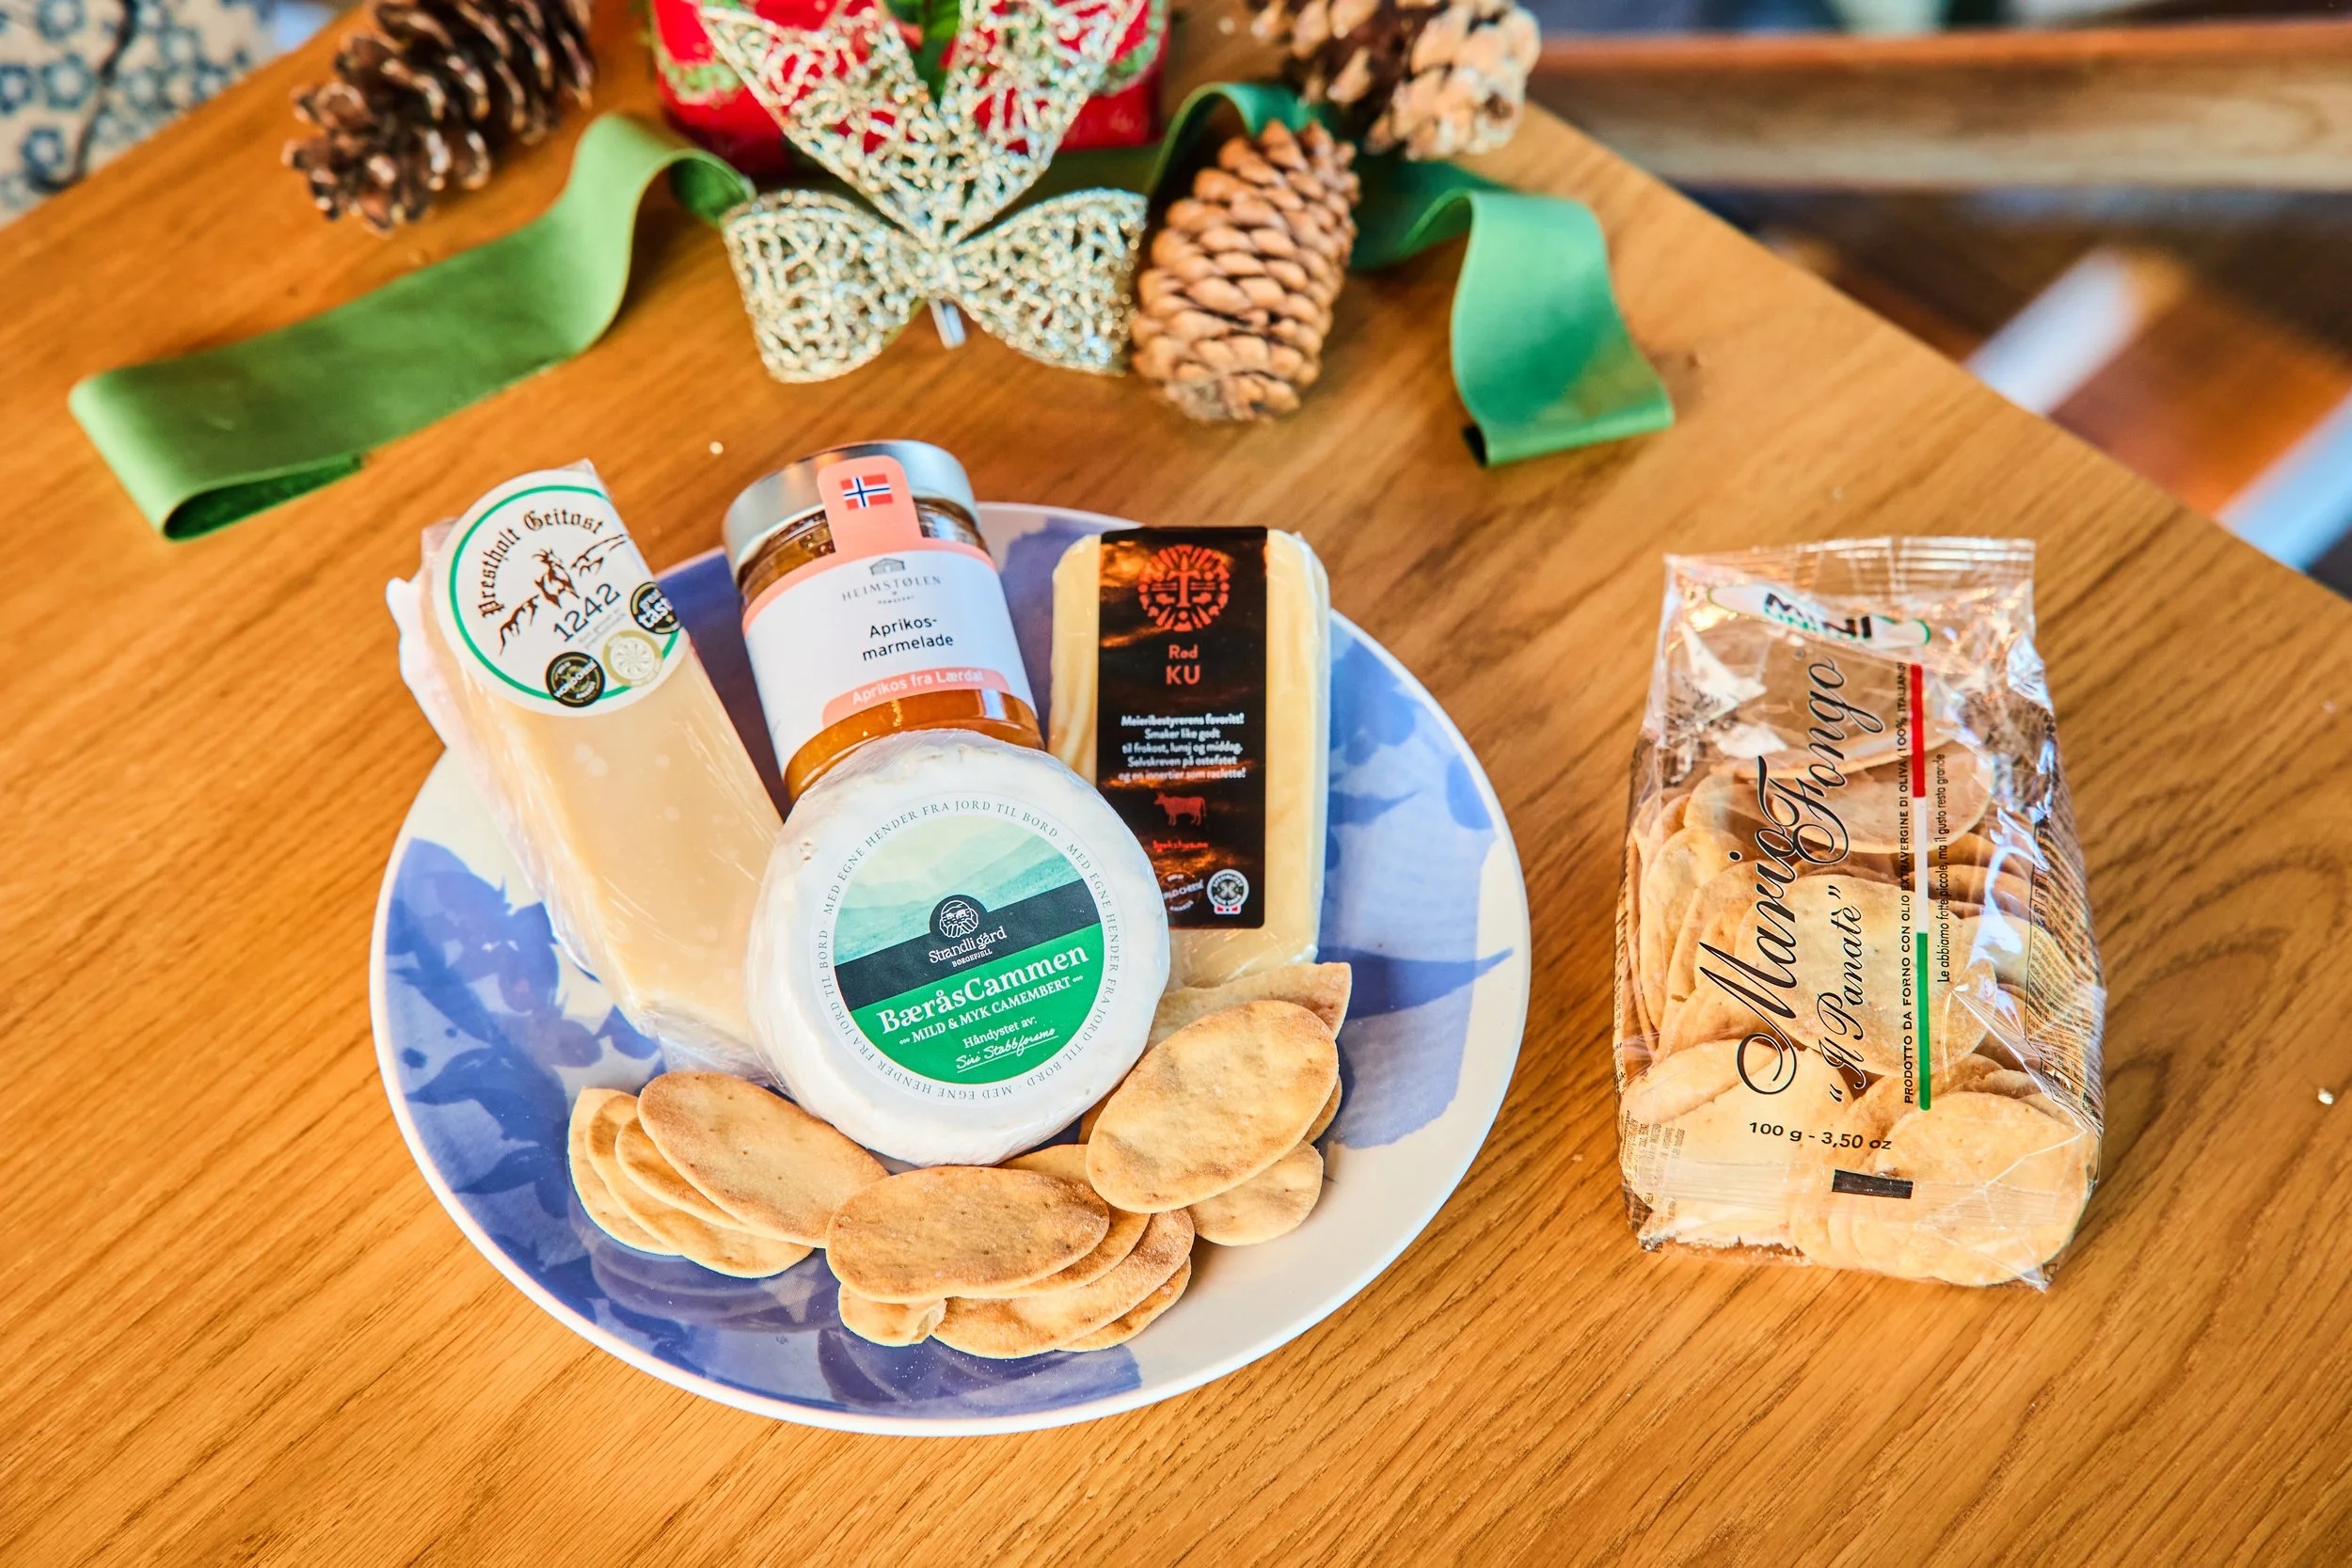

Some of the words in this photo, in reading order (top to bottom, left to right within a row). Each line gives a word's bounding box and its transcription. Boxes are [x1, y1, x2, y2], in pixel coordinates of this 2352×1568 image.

[841, 576, 942, 602] HEIMSTØLEN
[553, 583, 621, 641] 1242
[869, 617, 937, 639] Aprikos-
[863, 634, 954, 661] marmelade
[852, 679, 908, 705] Aprikos
[910, 673, 932, 688] fra
[935, 670, 984, 684] Lærdal
[1166, 664, 1200, 685] KU
[1899, 760, 1908, 793] OLIVA
[1932, 753, 1948, 785] grande
[1899, 796, 1908, 807] DI
[1935, 787, 1947, 809] resta
[1935, 811, 1950, 835] gusto
[823, 885, 841, 915] MED
[837, 847, 866, 880] EGNE
[866, 811, 919, 847] HENDER
[922, 801, 949, 816] FRA
[955, 800, 991, 811] JORD
[997, 803, 1017, 817] TIL
[1023, 813, 1057, 837] BORD
[1066, 843, 1090, 870] MED
[1899, 811, 1910, 892] EXTRAVERGINE
[1937, 845, 1948, 860] ma
[1089, 872, 1112, 909] EGNE
[1934, 863, 1950, 897] piccole,
[1900, 895, 1911, 922] OLIO
[818, 930, 829, 970] BORD
[929, 937, 977, 964] Strandli
[977, 926, 1008, 950] gård
[1105, 913, 1120, 972] HENDER
[1900, 925, 1911, 953] CON
[1936, 923, 1949, 968] abbiamo
[1697, 825, 1798, 1095] Mario
[821, 974, 834, 998] TIL
[876, 946, 1089, 1035] BæråsCammen
[1101, 978, 1117, 1004] FRA
[1901, 957, 1912, 1006] FORNO
[1937, 971, 1950, 983] Le
[830, 1002, 855, 1036] JORD
[912, 1022, 946, 1043] MILD
[947, 1018, 959, 1030] &
[960, 1006, 992, 1026] MYK
[992, 975, 1072, 1013] CAMEMBERT
[1902, 1012, 1913, 1030] DA
[961, 1021, 1020, 1049] Håndystet
[1021, 1015, 1038, 1028] av:
[1083, 1007, 1106, 1041] JORD
[852, 1037, 875, 1062] FRA
[956, 1053, 981, 1070] Siri
[1063, 1045, 1084, 1062] TIL
[877, 1059, 932, 1094] HENDER
[1026, 1061, 1062, 1087] BORD
[1902, 1036, 1914, 1105] PRODOTTO
[937, 1087, 975, 1100] EGNE
[982, 1085, 1012, 1099] MED
[1749, 1122, 1784, 1136] 100
[1789, 1130, 1803, 1142] g
[1821, 1132, 1863, 1148] 3,50
[1868, 1139, 1892, 1149] oz
